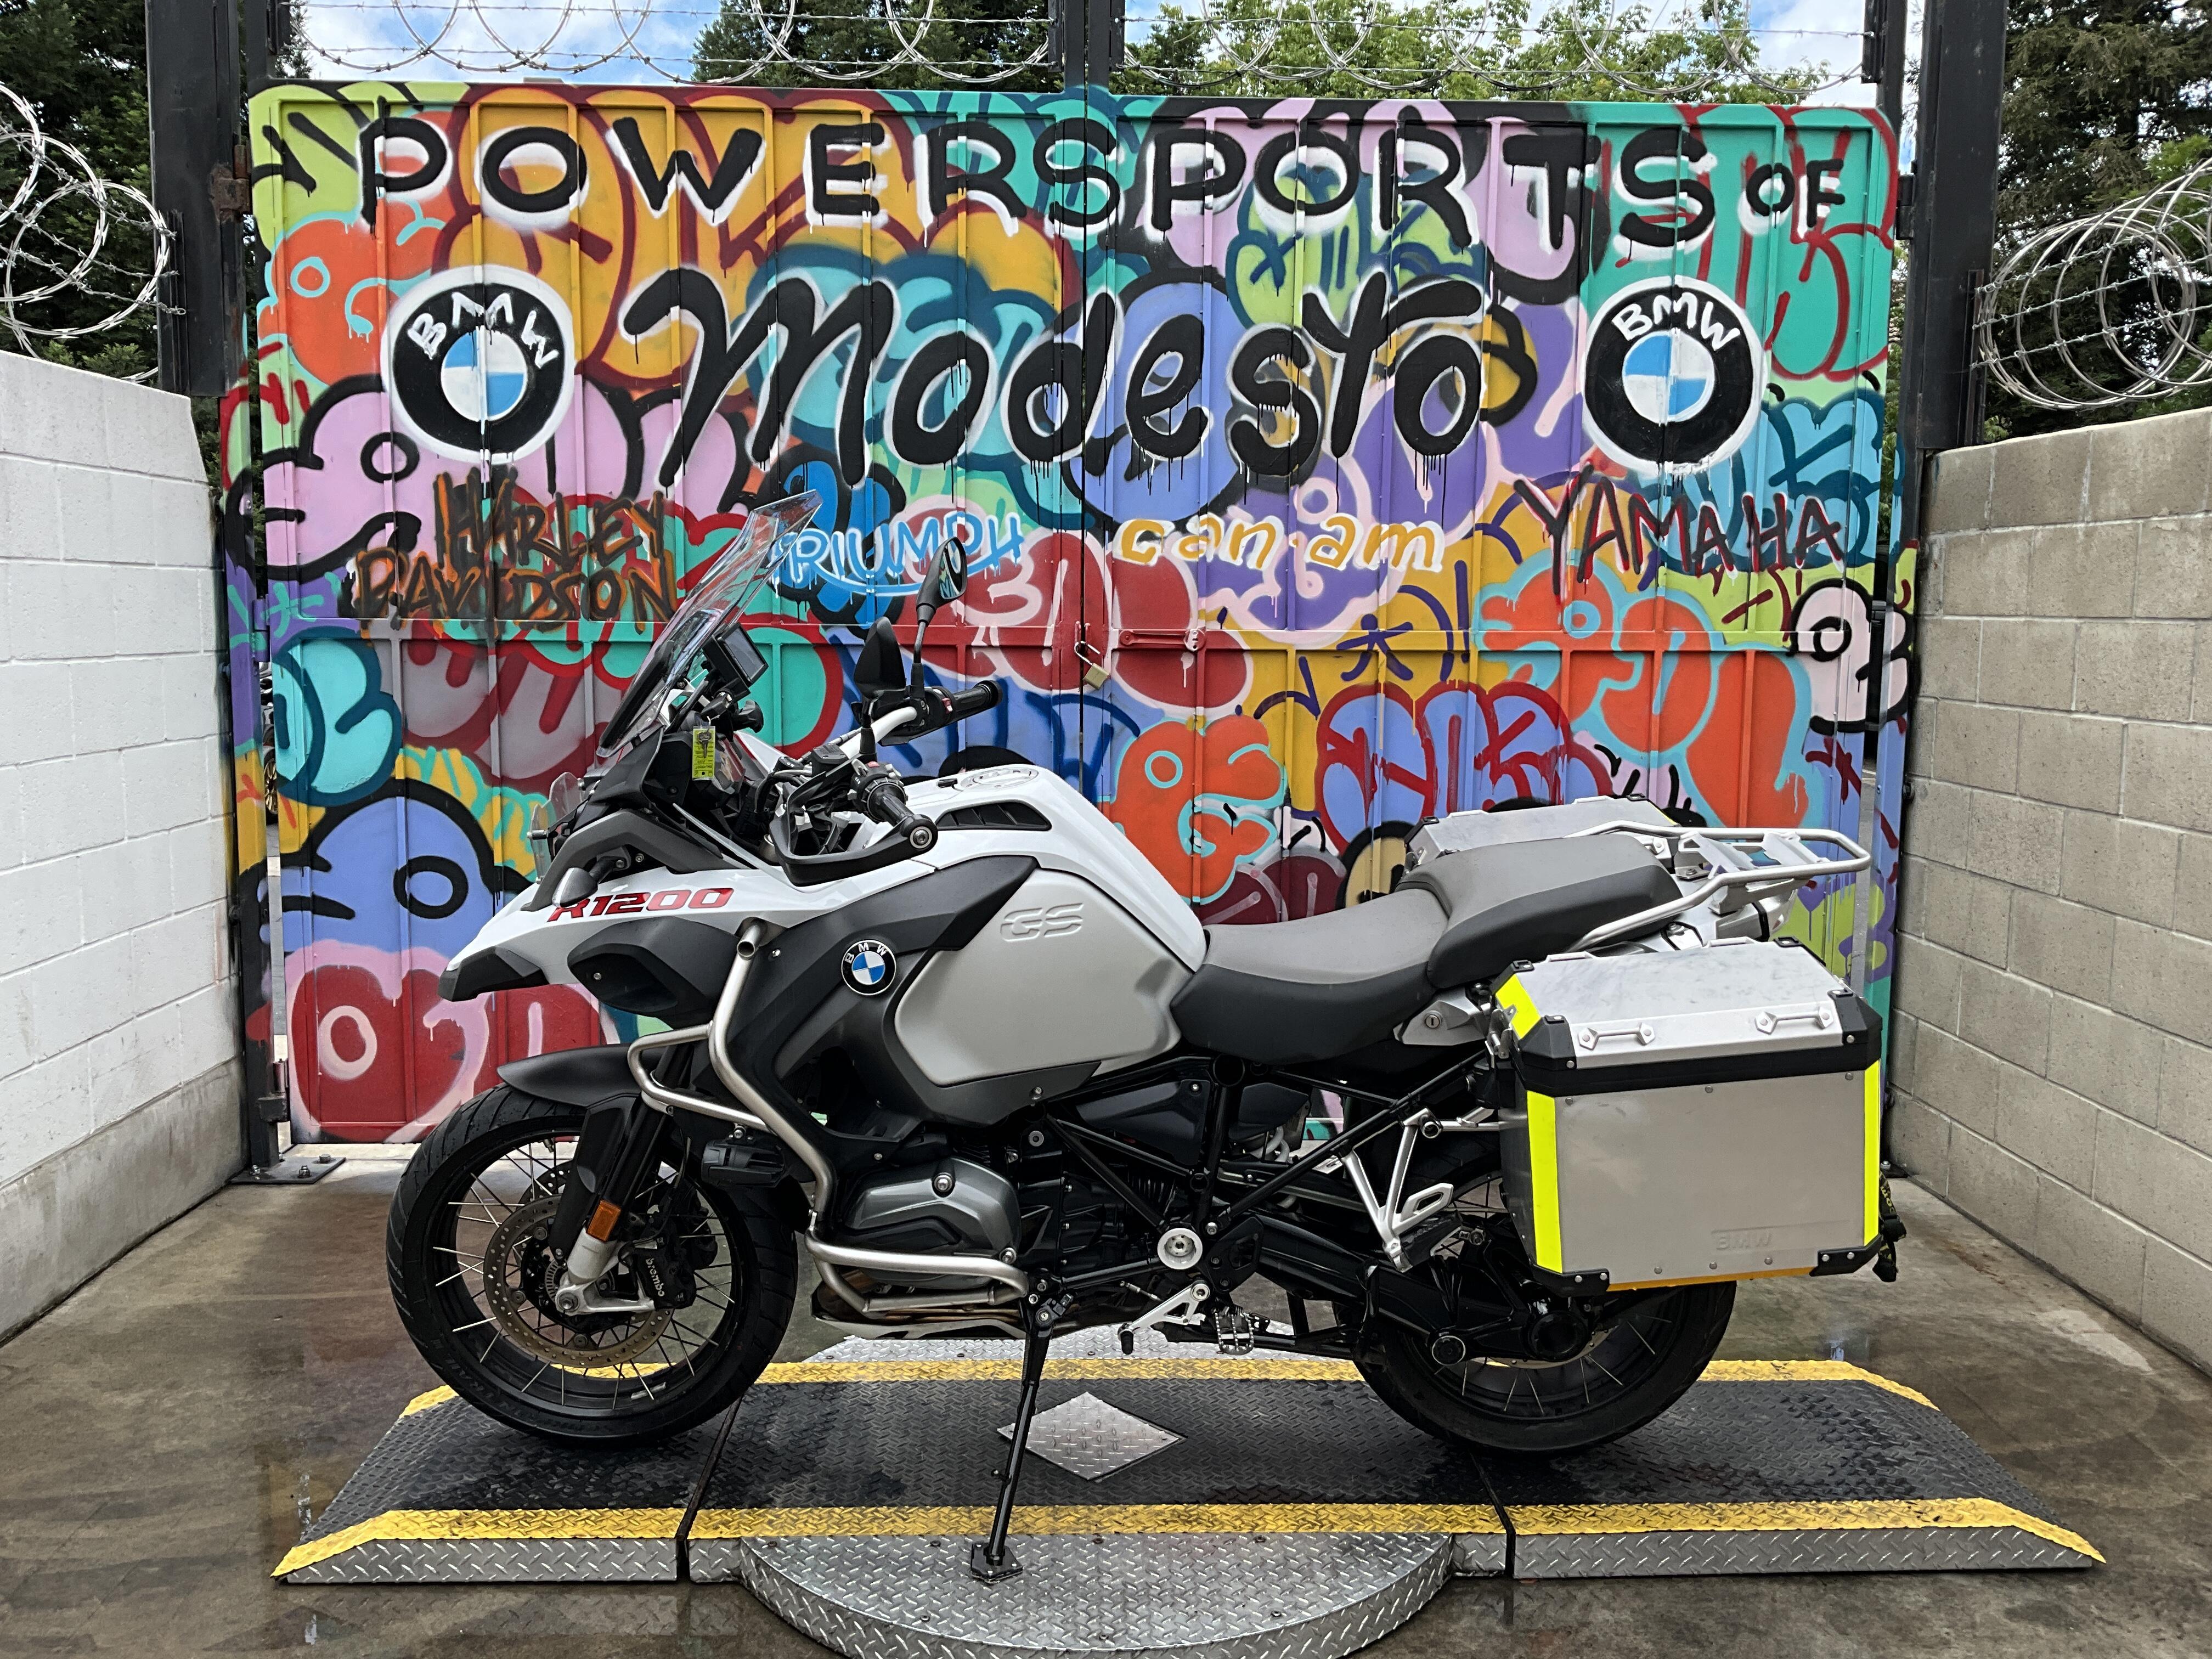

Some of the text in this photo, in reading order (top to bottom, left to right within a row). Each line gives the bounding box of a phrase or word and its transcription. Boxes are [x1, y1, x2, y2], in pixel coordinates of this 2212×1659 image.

[361, 107, 1845, 249] POWERSPORTS OF
[407, 291, 559, 368] BMW
[1612, 293, 1741, 351] BMW
[433, 467, 665, 572] HARLEY
[1513, 464, 1847, 597] YAMAHA
[547, 888, 734, 922] R1200
[1000, 902, 1084, 941] GS
[845, 942, 887, 964] BMW
[1716, 1231, 1773, 1250] BMW
[645, 1257, 665, 1297] brembo
